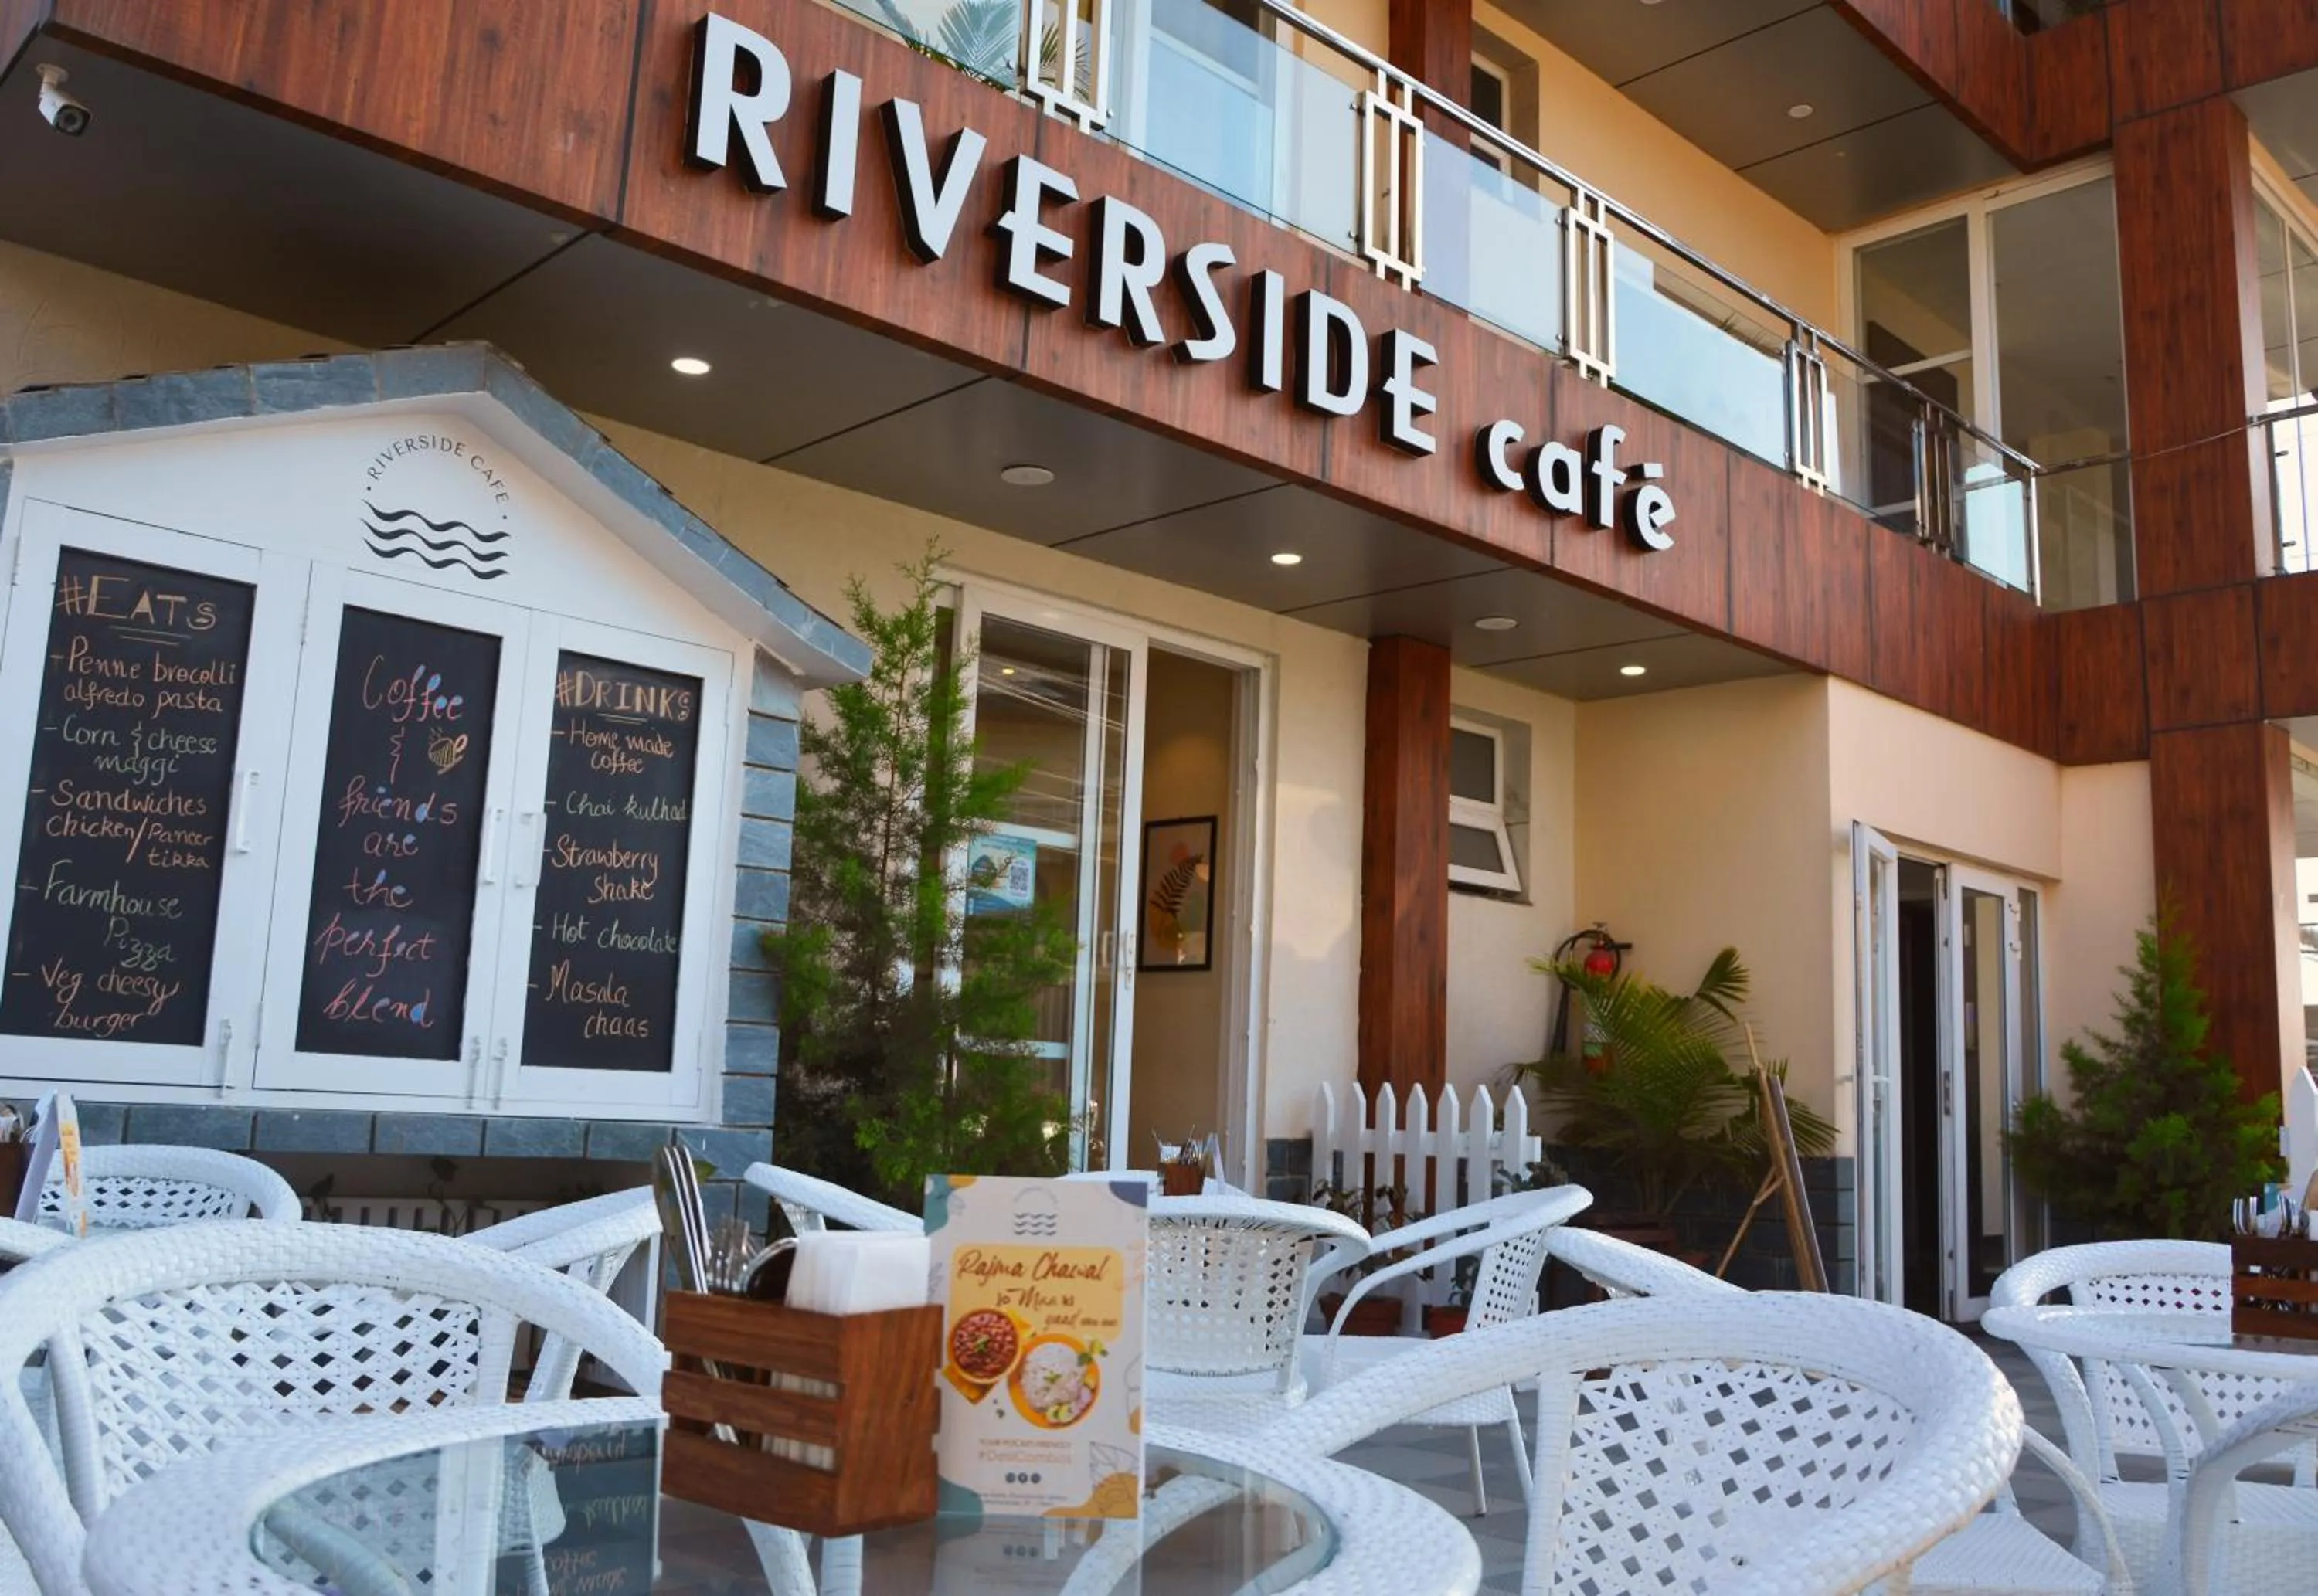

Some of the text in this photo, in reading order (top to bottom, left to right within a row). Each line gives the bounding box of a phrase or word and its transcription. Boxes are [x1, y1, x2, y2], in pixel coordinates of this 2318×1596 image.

[683, 11, 1439, 457] RIVERSIDE
[366, 434, 510, 504] RIVERSIDE CAFE
[68, 635, 141, 680] Penne
[63, 679, 224, 720] alfredo pasta
[362, 654, 463, 722] Coffee
[556, 669, 692, 722] #DRINKS
[63, 714, 121, 746] Corn
[147, 728, 218, 754] cheese
[569, 718, 676, 758] Home made
[93, 753, 181, 786] maggi
[51, 779, 207, 816] Sandwiches
[338, 774, 458, 828] friends
[566, 790, 687, 822] Chai kulhad
[551, 833, 659, 885] Strawberry
[342, 867, 414, 908] the
[314, 912, 437, 978] perfect
[552, 912, 590, 944] Hot
[41, 955, 180, 1016] Veg cheesy
[323, 978, 435, 1028] blend
[546, 959, 630, 1007] Masala
[53, 1003, 145, 1038] burger
[957, 1249, 1112, 1287] Rajma Chawal
